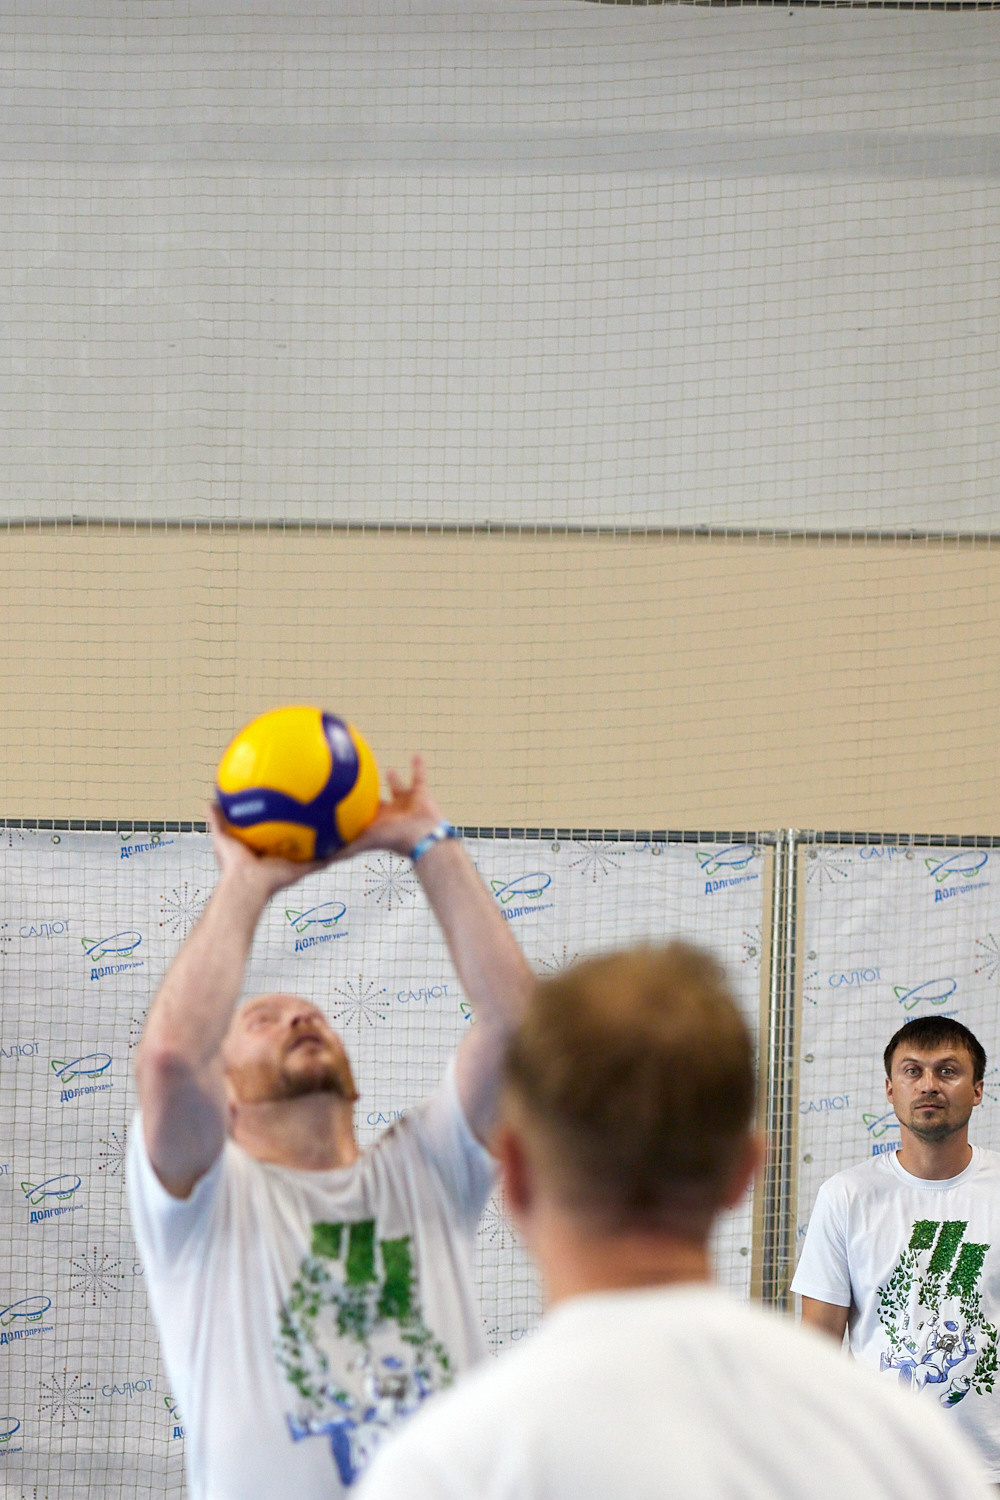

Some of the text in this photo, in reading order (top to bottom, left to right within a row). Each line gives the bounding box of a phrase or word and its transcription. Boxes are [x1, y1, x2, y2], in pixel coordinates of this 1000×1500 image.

[19, 921, 70, 939] САЛЮТ
[829, 968, 881, 987] САЛЮТ
[397, 985, 448, 1003] САЛЮТ
[102, 1379, 152, 1398] САЛЮТ
